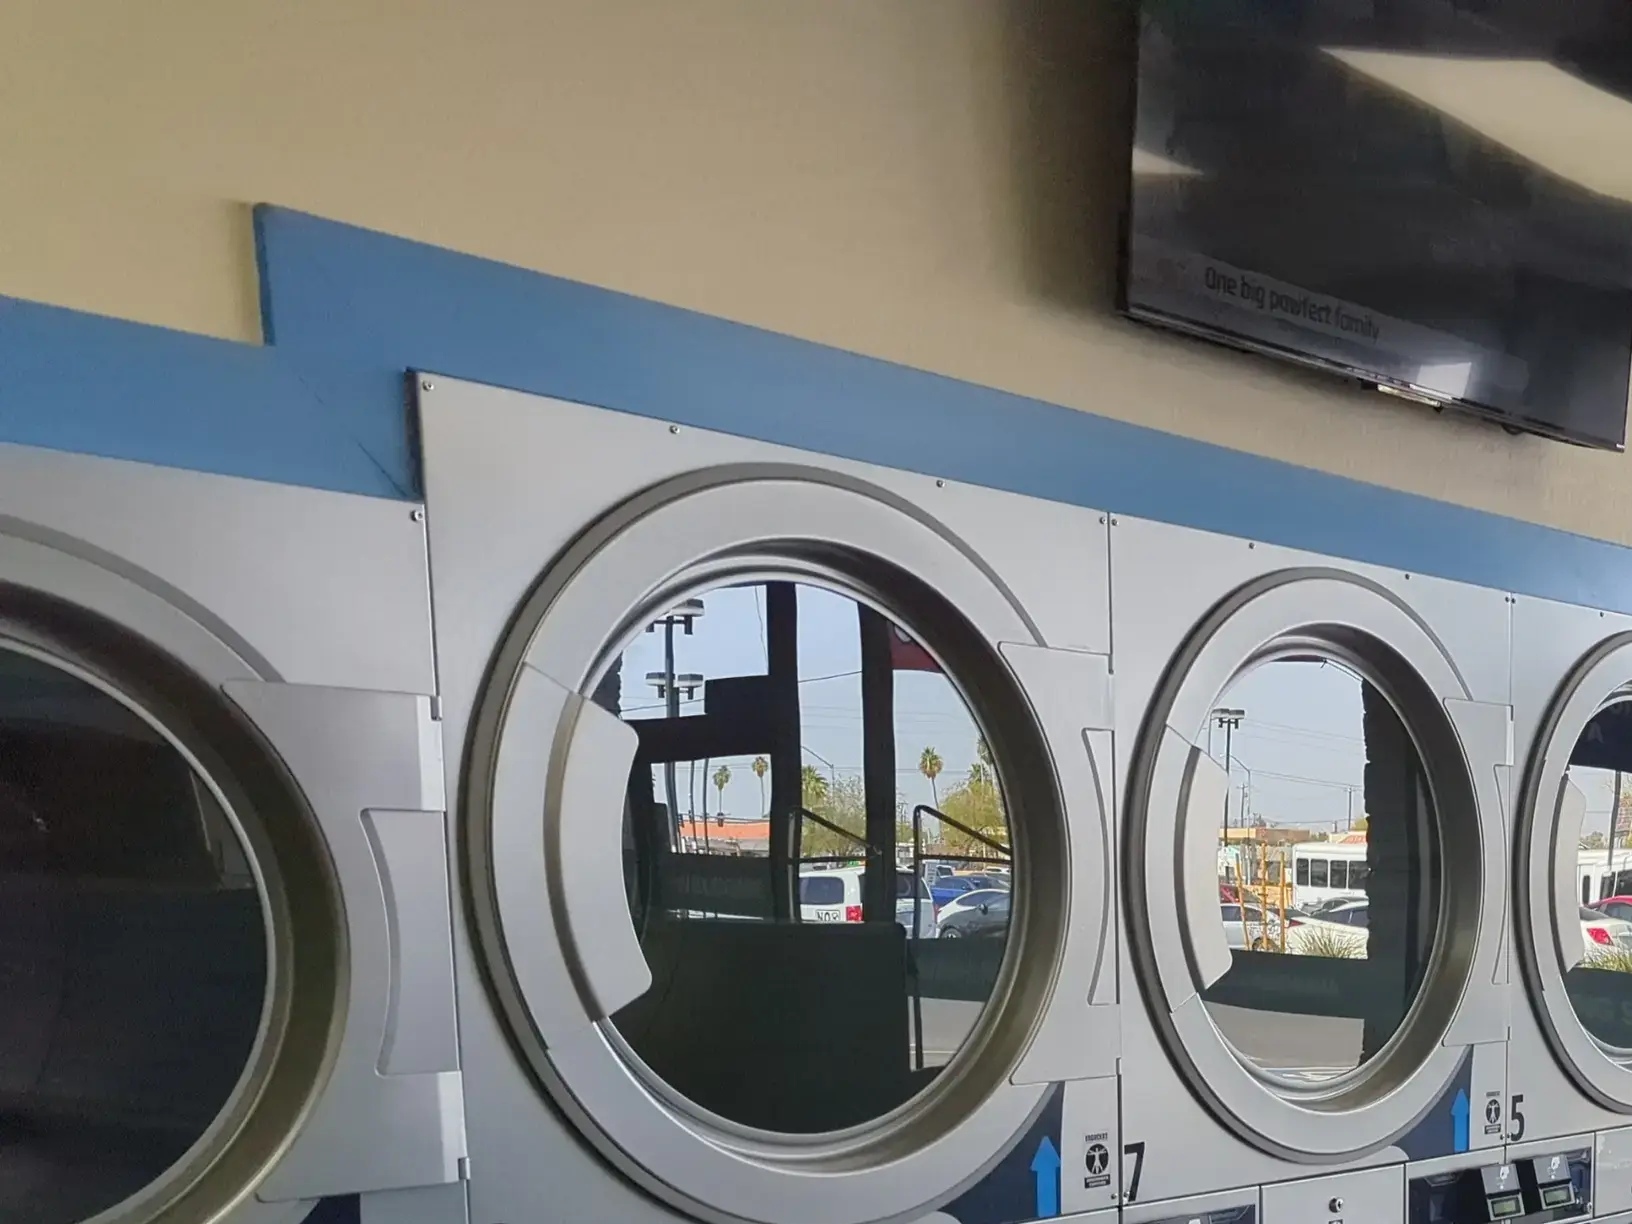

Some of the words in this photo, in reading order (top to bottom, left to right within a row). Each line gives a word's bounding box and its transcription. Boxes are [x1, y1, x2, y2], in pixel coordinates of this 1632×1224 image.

[1204, 266, 1237, 296] One
[1241, 275, 1265, 310] big
[1334, 301, 1380, 342] family
[1510, 1094, 1525, 1142] 5
[1124, 1141, 1146, 1201] 7
